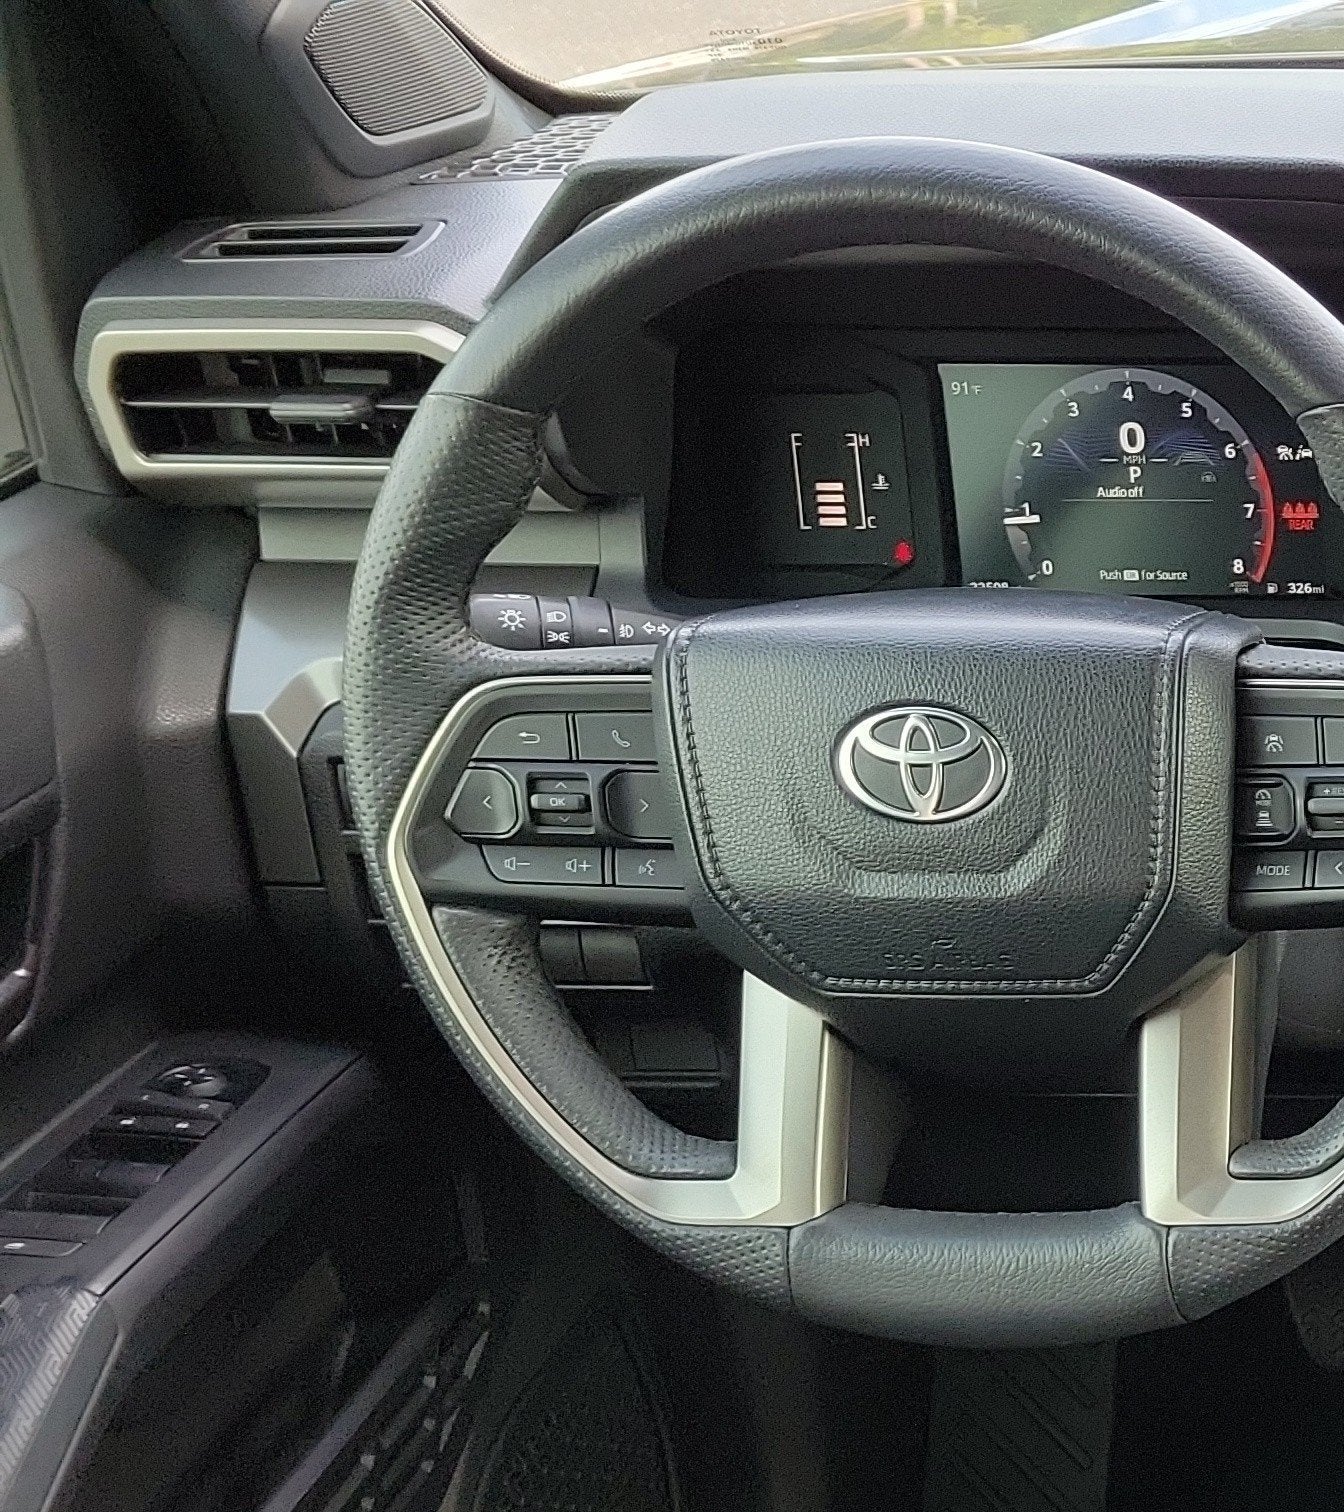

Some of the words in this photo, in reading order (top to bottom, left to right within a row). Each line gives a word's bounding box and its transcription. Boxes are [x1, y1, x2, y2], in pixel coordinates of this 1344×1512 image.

[1122, 386, 1134, 402] 4
[1067, 402, 1080, 417] 3
[1181, 402, 1193, 418] 5
[858, 433, 870, 447] H
[1119, 421, 1146, 454] 0
[1031, 442, 1043, 458] 2
[1224, 443, 1236, 459] 6
[1123, 455, 1147, 465] MPH
[1129, 466, 1142, 483] P
[1096, 486, 1127, 498] Audio
[1128, 486, 1144, 498] off
[1243, 503, 1255, 519] 7
[867, 516, 877, 529] C
[1288, 519, 1315, 531] REAR
[1041, 560, 1053, 575] 0
[1232, 558, 1244, 574] 8
[1100, 569, 1122, 580] Push
[1141, 569, 1155, 580] for
[1156, 569, 1188, 580] Source
[549, 798, 566, 806] OK
[1256, 865, 1291, 876] MODE
